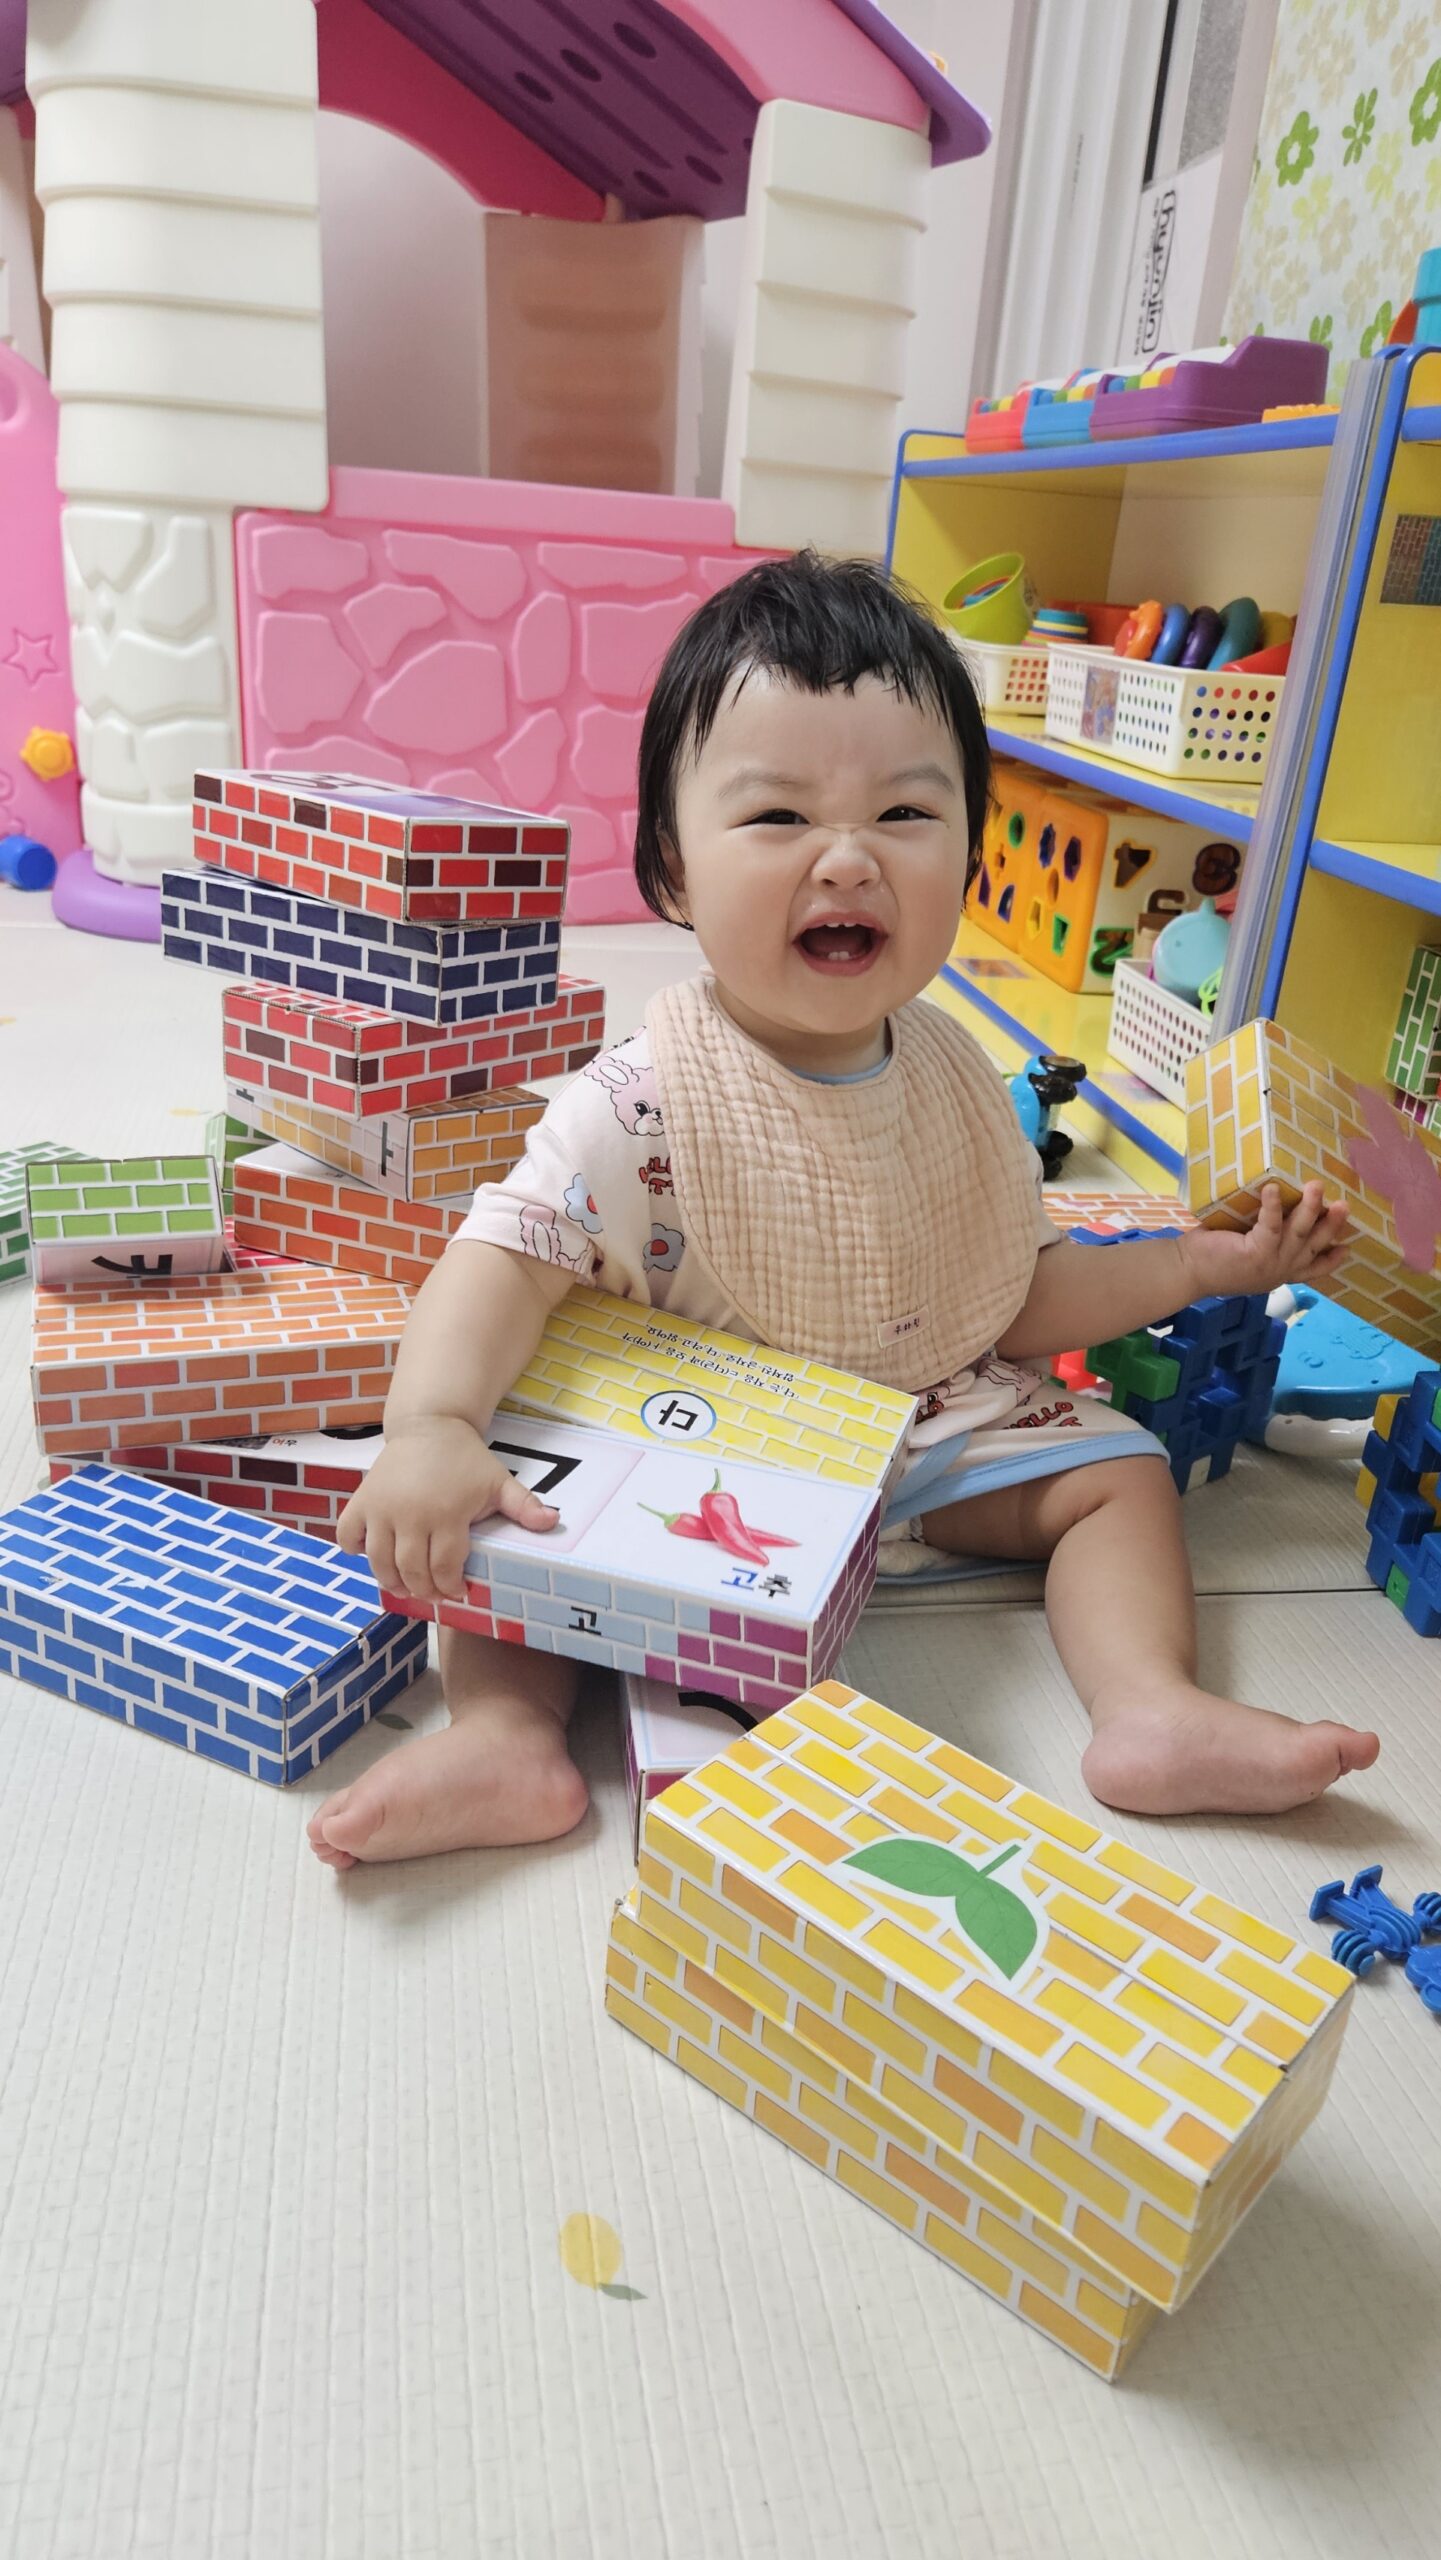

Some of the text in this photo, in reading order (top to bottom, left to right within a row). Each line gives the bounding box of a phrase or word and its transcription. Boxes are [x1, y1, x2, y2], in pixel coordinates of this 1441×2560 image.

[665, 1346, 687, 1360] 모음
[725, 1353, 758, 1369] 글자로
[744, 1373, 766, 1389] 자음
[658, 1399, 699, 1431] 다
[1002, 1401, 1075, 1430] ELLO
[721, 1565, 793, 1599] 고추
[567, 1606, 602, 1636] 고
